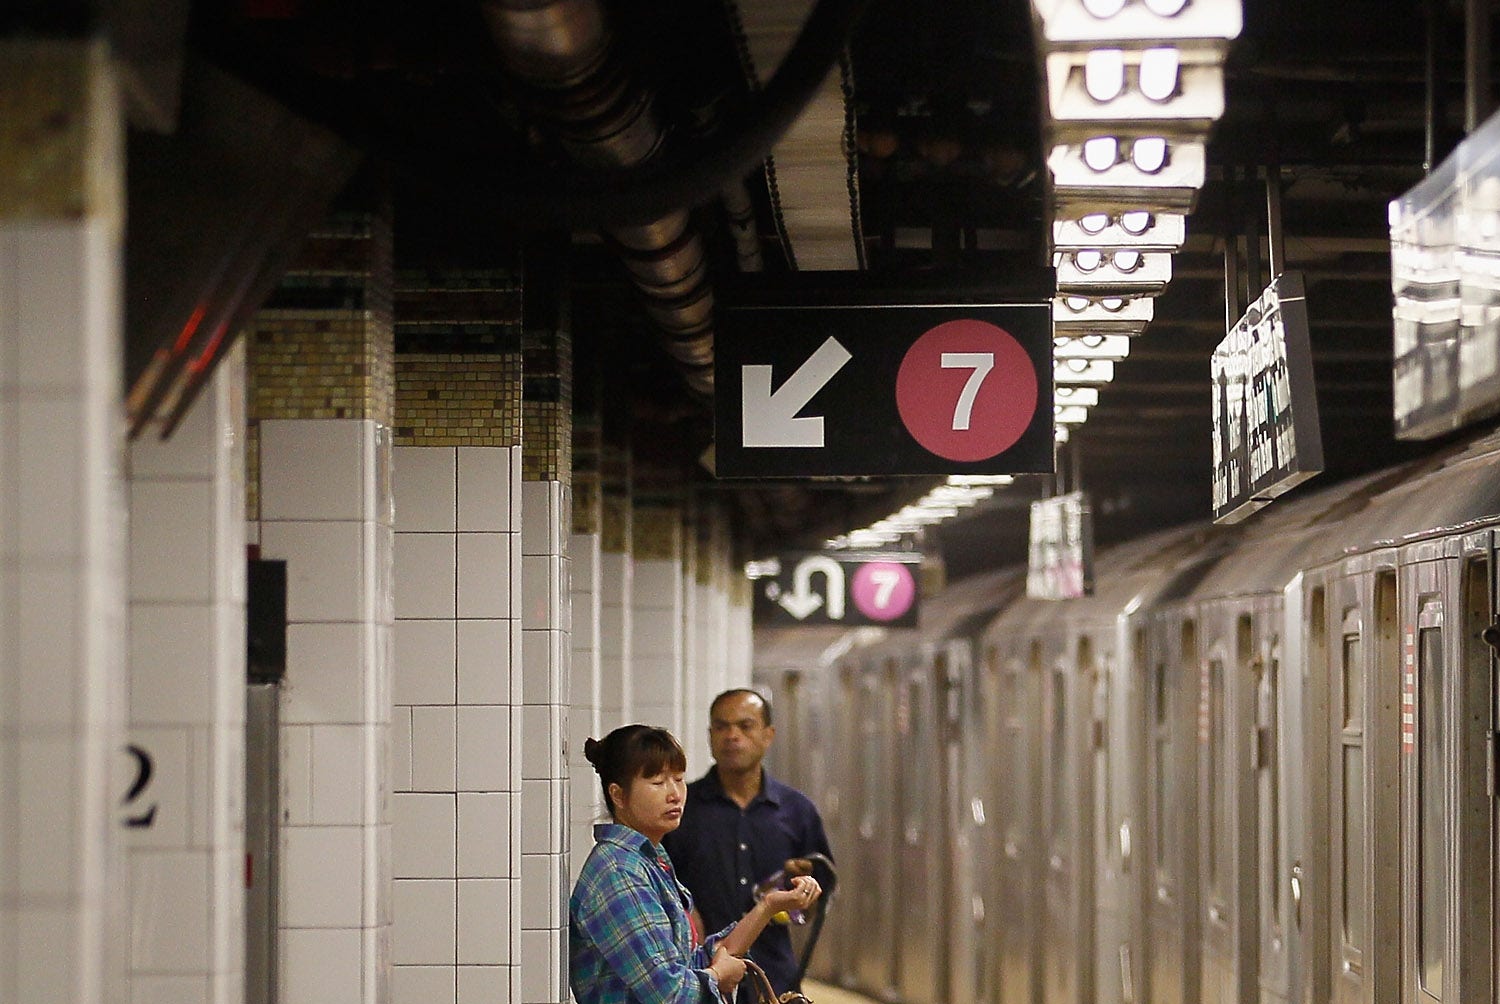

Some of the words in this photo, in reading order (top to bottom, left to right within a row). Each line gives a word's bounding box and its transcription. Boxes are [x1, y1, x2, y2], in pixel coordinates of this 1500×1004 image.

[940, 352, 995, 431] 7
[870, 570, 900, 609] 7
[121, 743, 157, 828] 2
